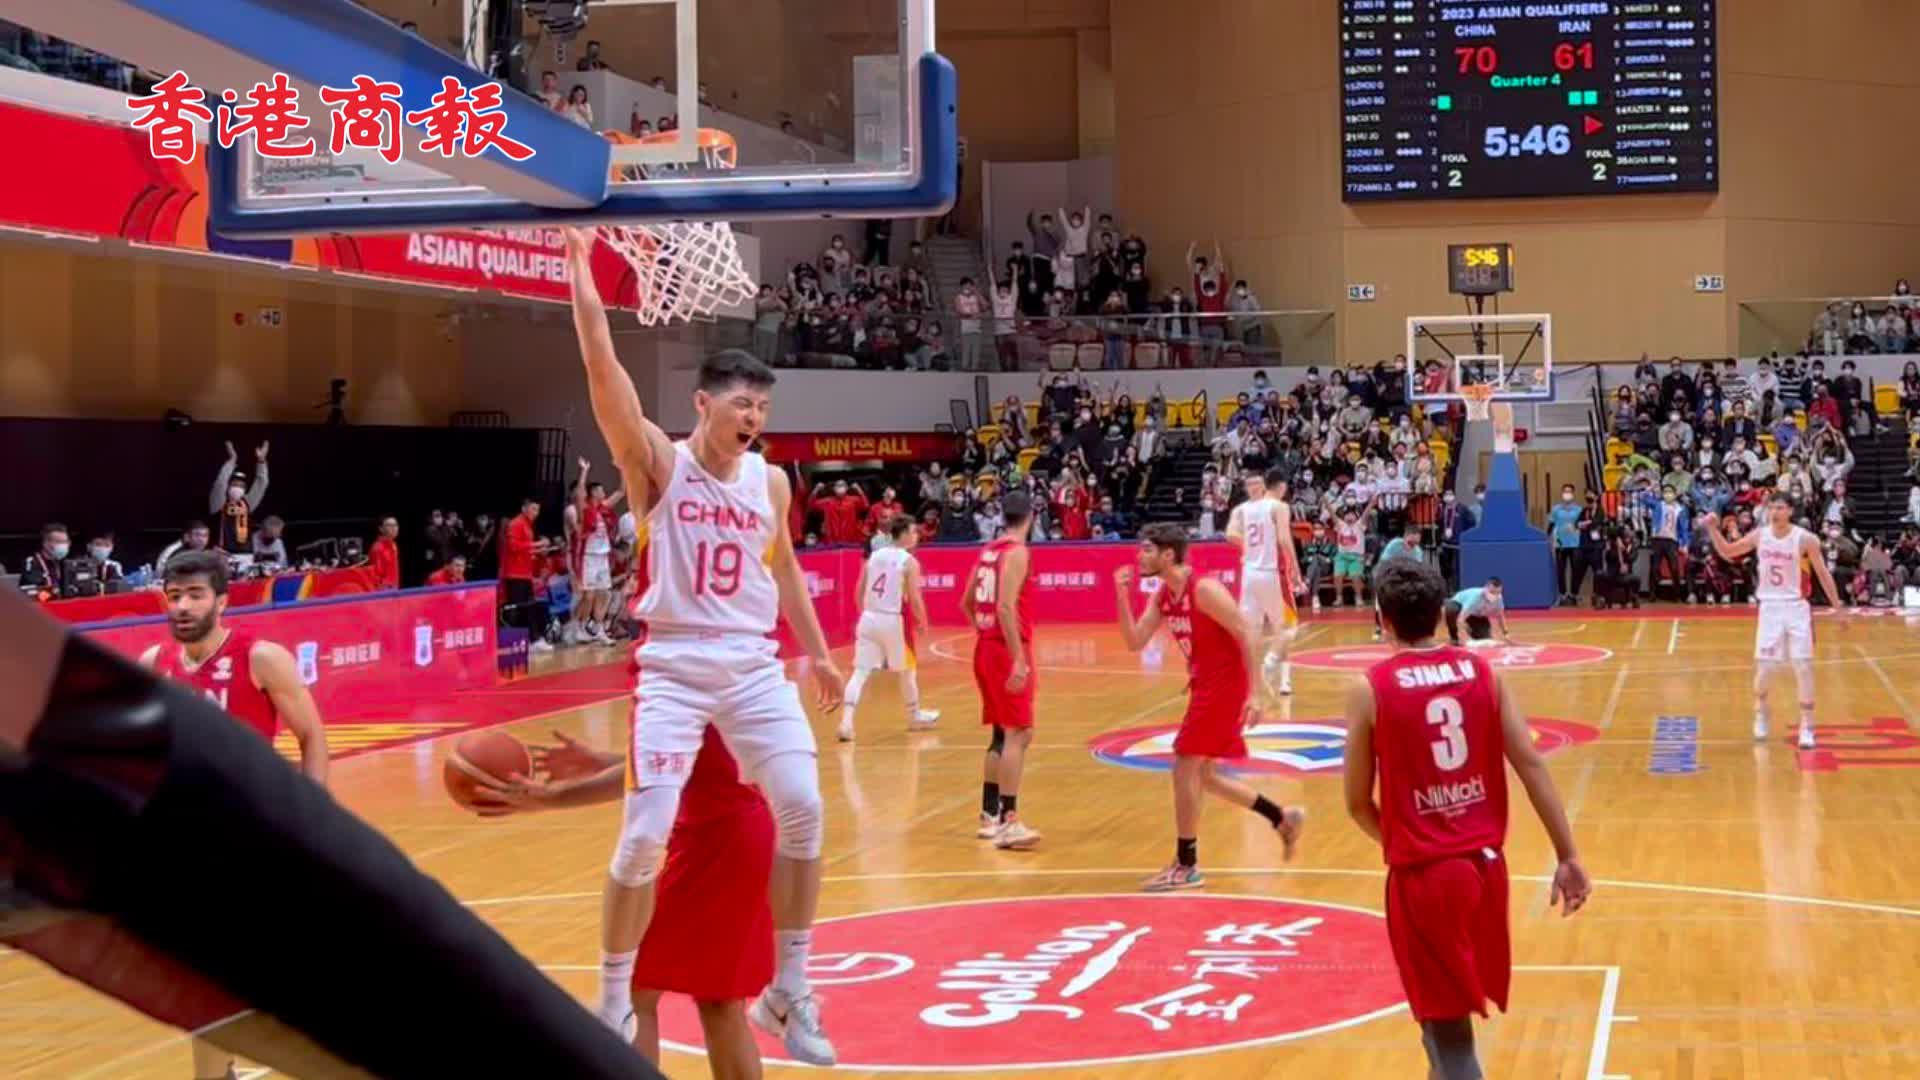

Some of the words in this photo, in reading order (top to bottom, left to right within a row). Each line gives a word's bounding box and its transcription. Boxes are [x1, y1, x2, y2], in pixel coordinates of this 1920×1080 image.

[1441, 8, 1474, 20] 2023
[1478, 6, 1521, 19] ASIAN
[1525, 3, 1609, 17] QUALIFIERS
[1455, 24, 1496, 37] CHINA
[1558, 20, 1591, 33] IRAN
[1454, 46, 1497, 74] 70
[1554, 42, 1593, 70] 61
[1491, 75, 1548, 88] Quarter
[1551, 74, 1561, 85] 4
[1484, 124, 1571, 158] 5:46
[1441, 154, 1468, 163] FOUL
[1586, 149, 1612, 159] FOUL
[1448, 170, 1462, 187] 2
[1593, 164, 1607, 181] 2
[408, 232, 474, 269] ASIAN
[814, 437, 849, 456] WIN
[852, 438, 875, 449] FOR
[877, 437, 912, 455] ALL
[678, 500, 758, 532] CHINA
[696, 540, 742, 597] 19
[1770, 565, 1785, 586] 5
[871, 572, 887, 598] 4
[1425, 696, 1469, 771] 3
